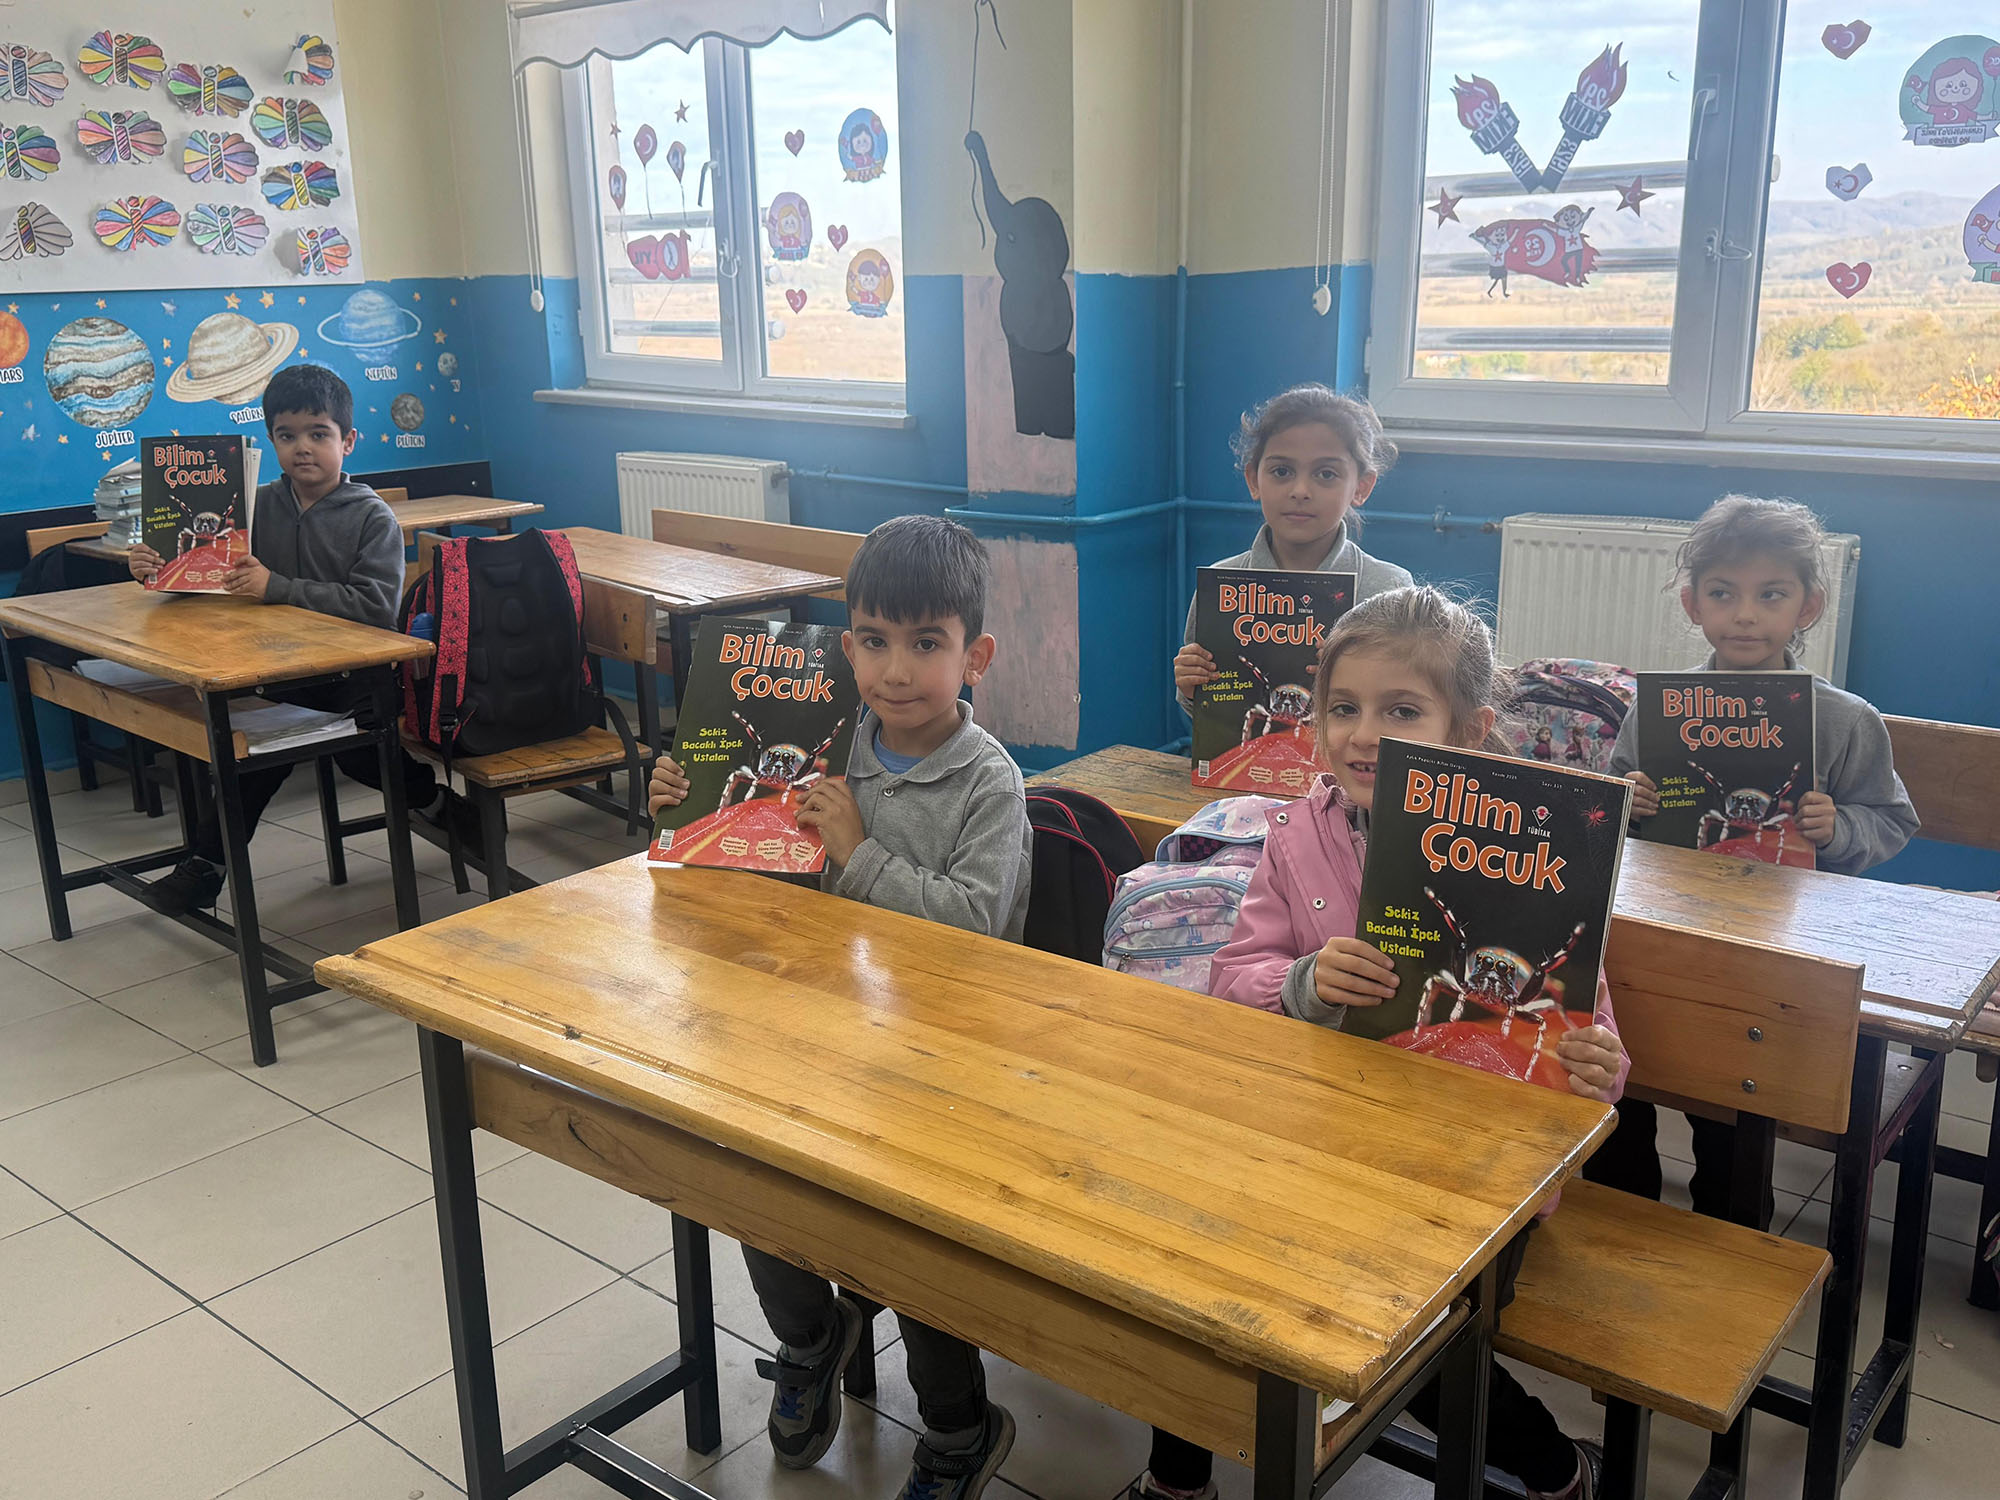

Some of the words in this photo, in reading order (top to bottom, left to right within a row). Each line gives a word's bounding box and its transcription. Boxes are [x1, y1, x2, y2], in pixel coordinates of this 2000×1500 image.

[96, 430, 135, 447] JÜPİTER
[154, 444, 205, 467] Bilim
[164, 463, 228, 489] Çocuk
[1219, 582, 1295, 616] Bilim
[1233, 614, 1326, 647] Çocuk
[719, 633, 805, 670] Bilim
[731, 666, 836, 703] Çocuk
[1662, 685, 1747, 718] Bilim
[699, 727, 728, 737] Sekiz
[719, 737, 744, 750] İpek
[1679, 717, 1784, 752] Çocuk
[1403, 769, 1522, 835] Bilim
[1527, 826, 1551, 838] TÜBİTAK
[1421, 823, 1567, 894] Çocuk
[1384, 905, 1420, 921] Sekiz
[1366, 921, 1407, 938] Bacaklı
[1410, 923, 1441, 942] İpek
